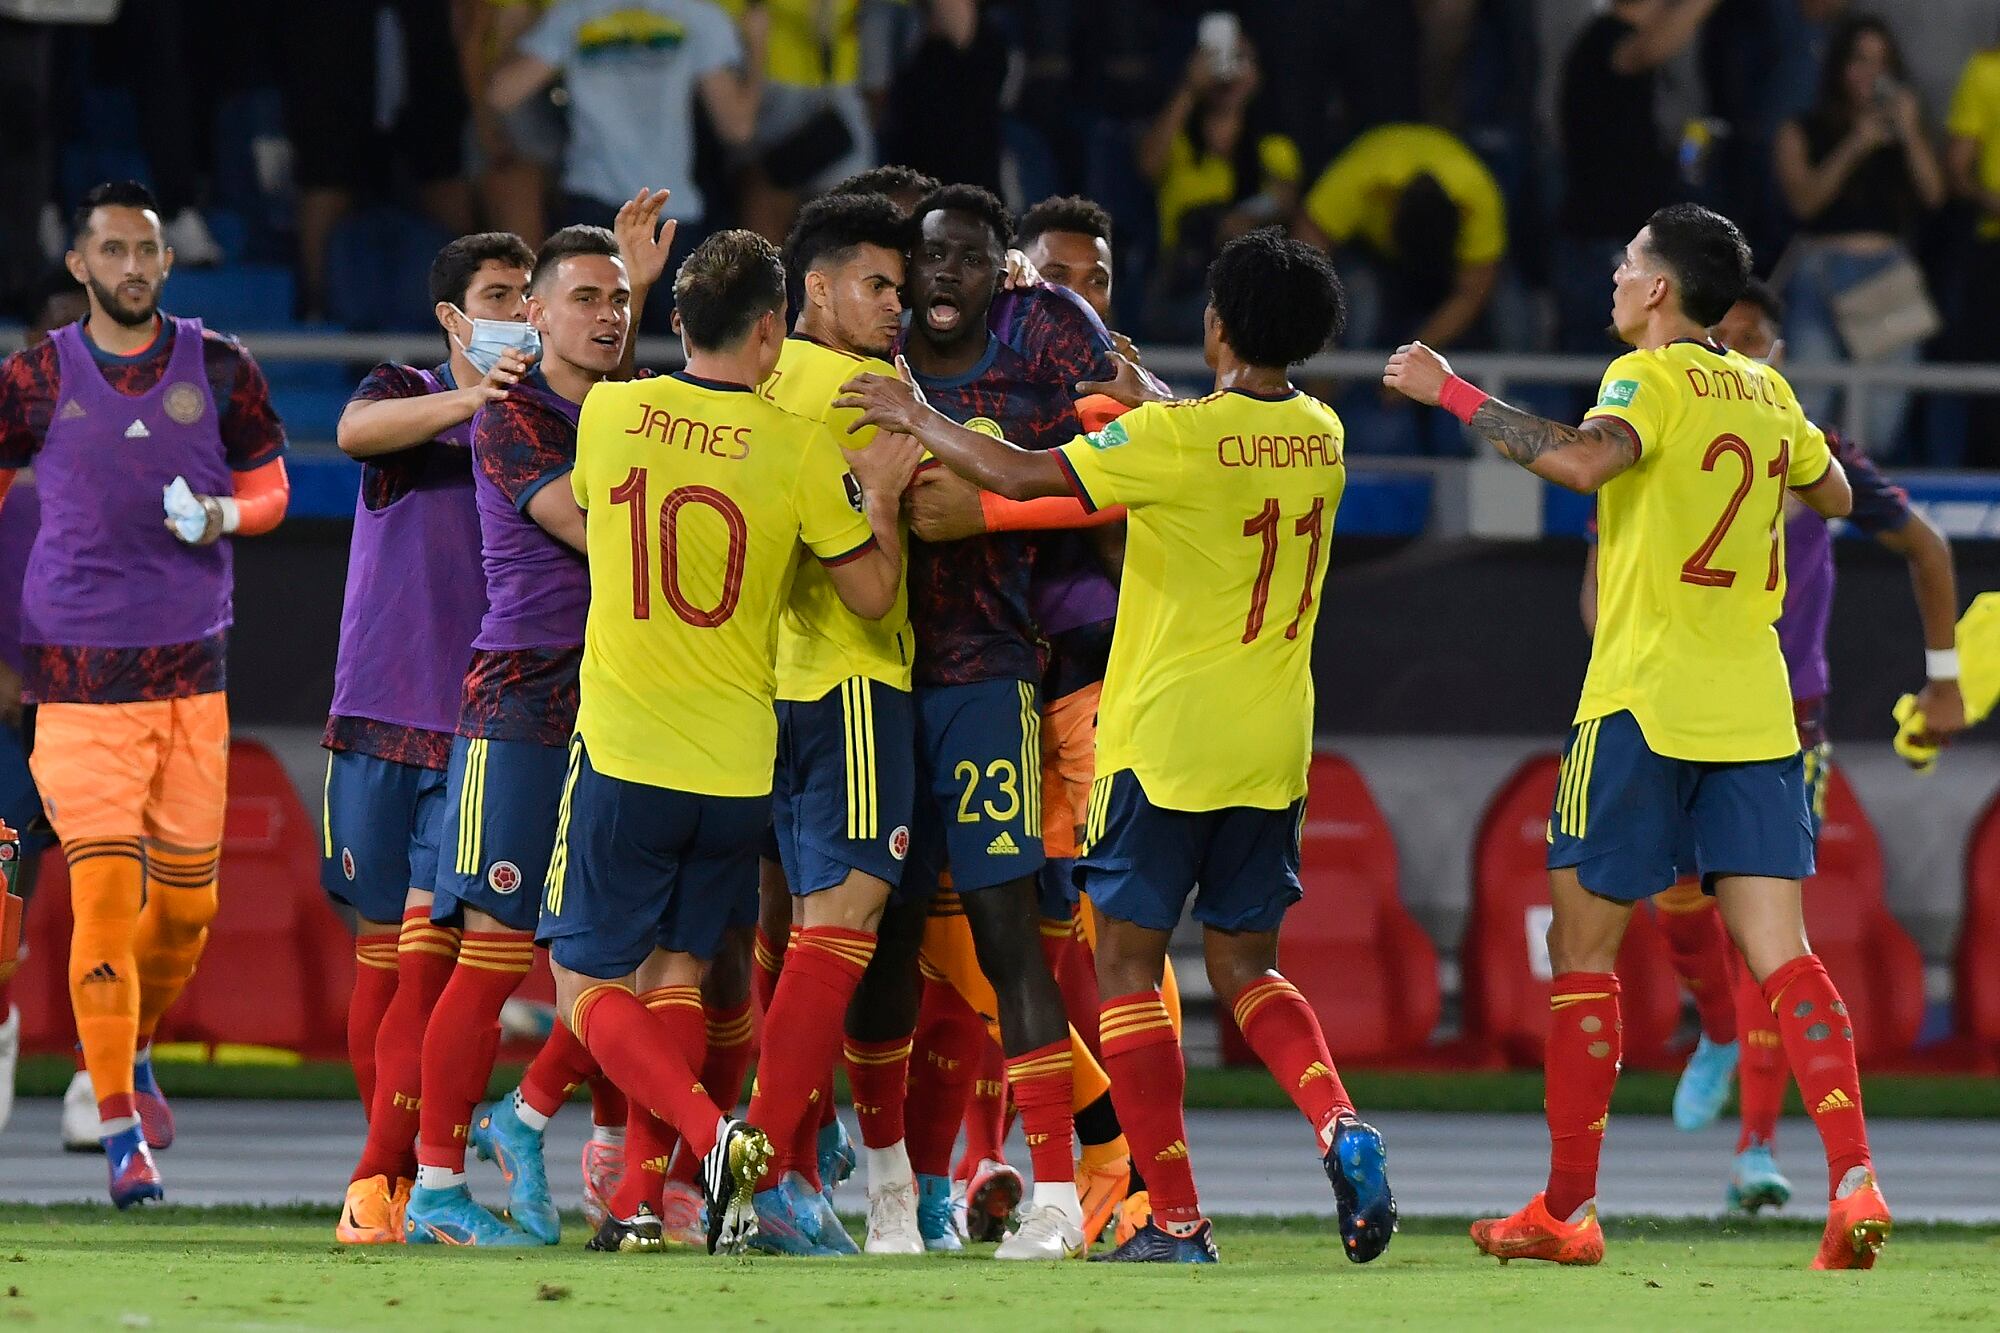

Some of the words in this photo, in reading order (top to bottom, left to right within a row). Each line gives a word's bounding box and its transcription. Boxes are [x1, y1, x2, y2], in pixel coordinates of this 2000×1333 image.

[625, 403, 752, 459] JAMES
[1686, 368, 1786, 410] D.MU
[610, 467, 748, 628] 10
[1680, 433, 1789, 591] 21
[1241, 497, 1324, 645] 11
[954, 759, 1020, 823] 23
